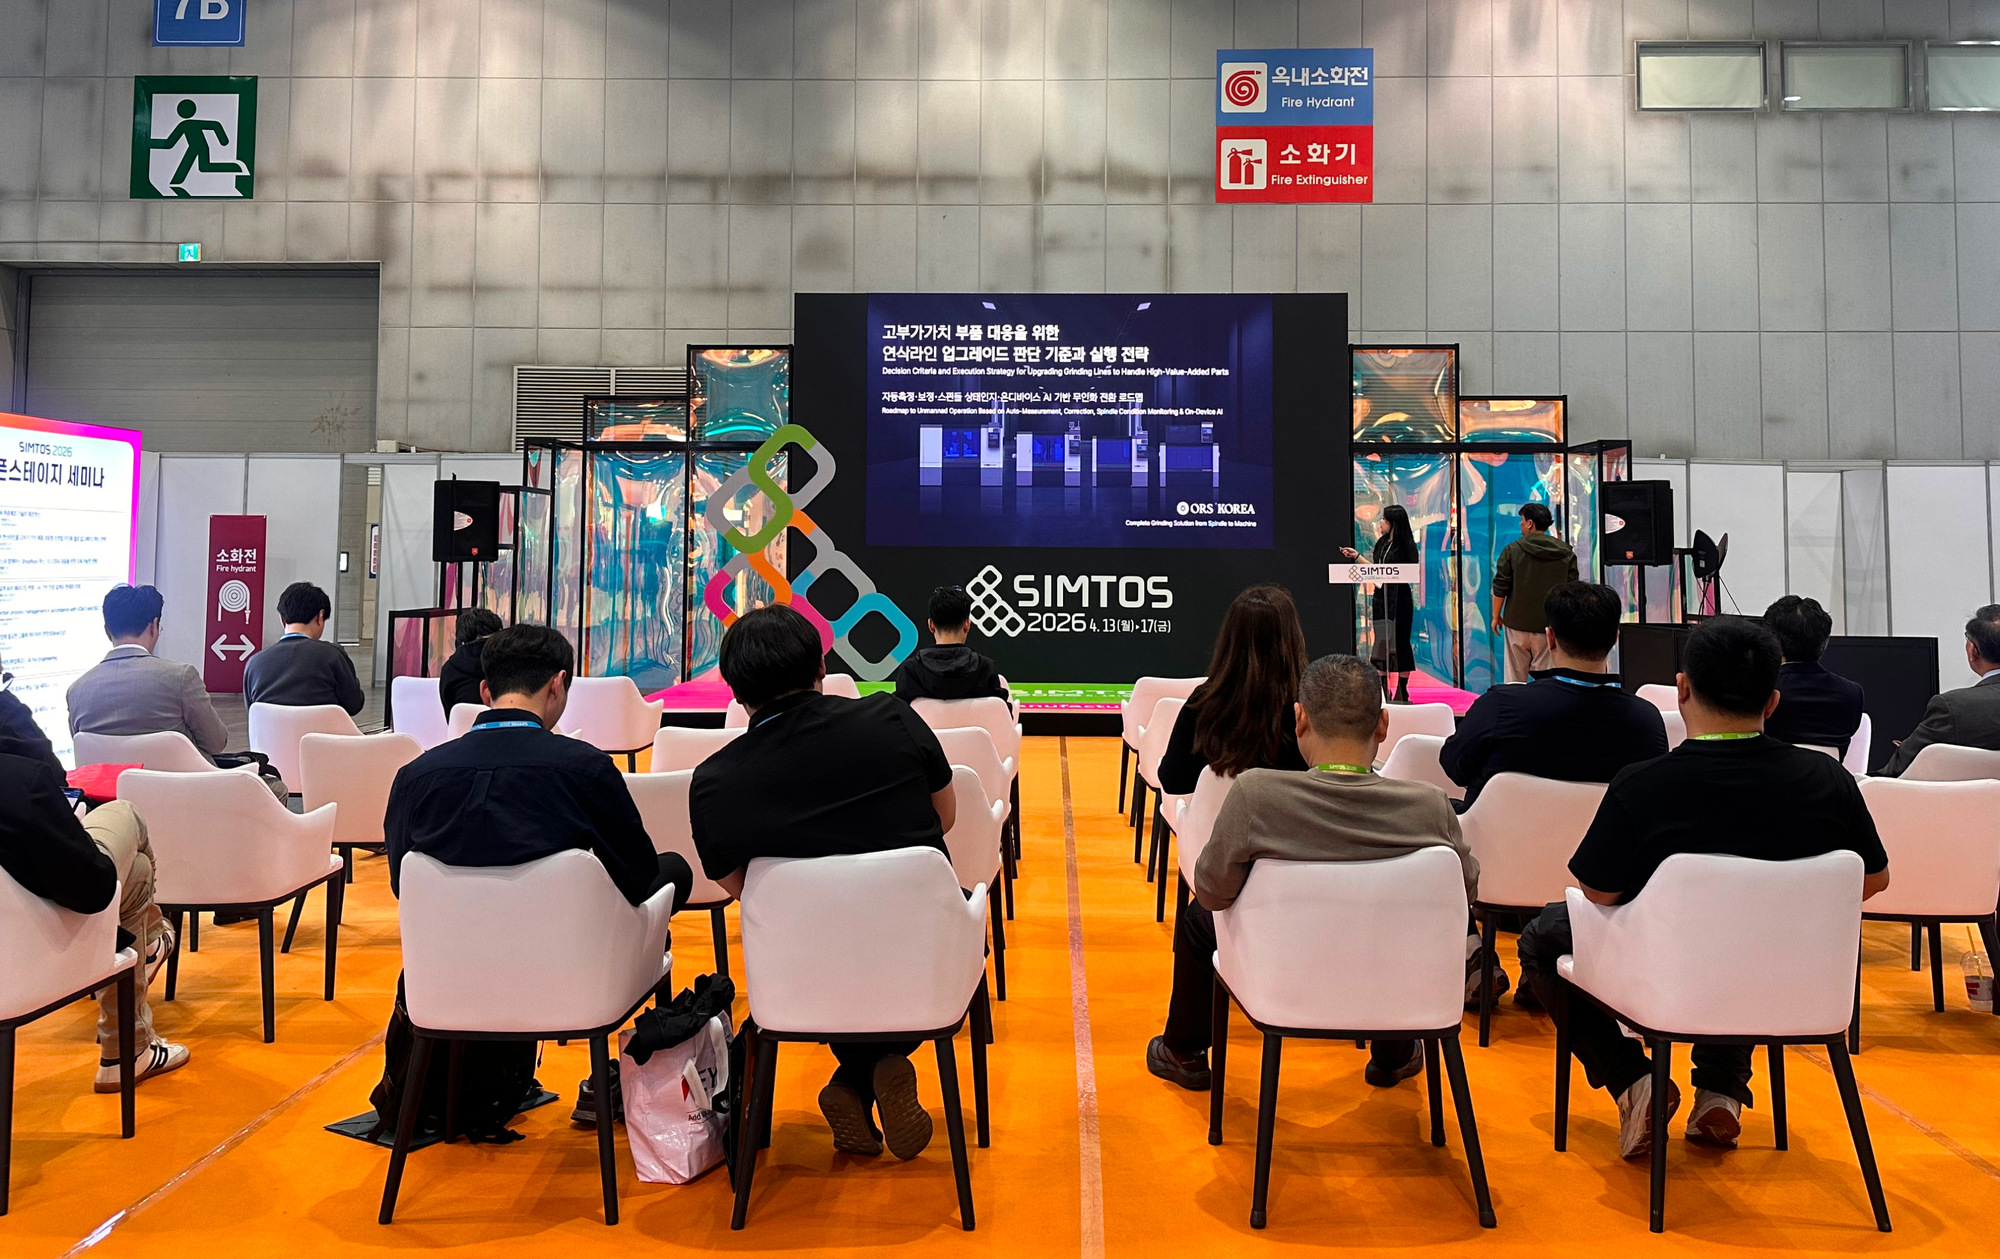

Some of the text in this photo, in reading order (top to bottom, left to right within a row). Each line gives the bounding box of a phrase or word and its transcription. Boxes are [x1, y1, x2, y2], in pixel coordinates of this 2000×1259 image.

[1271, 66, 1368, 86] 옥내소화전
[1281, 96, 1355, 109] Fire Hydrant
[1271, 174, 1368, 187] Fire Extinguisher
[882, 324, 1060, 341] 고부가가치 부품 대응을 위한
[882, 346, 1149, 363] 연삭라인 업그레이드 판단 기준과 실행 전략
[882, 367, 911, 375] Decision
[912, 367, 937, 375] Criteria
[952, 367, 985, 375] Execution
[986, 367, 1015, 377] Strategy
[1016, 367, 1026, 376] for
[1027, 367, 1063, 377] Upgrading
[1063, 368, 1092, 377] Grinding
[1093, 368, 1111, 376] Lines
[1121, 368, 1145, 376] Handle
[1146, 368, 1209, 378] High-Value-Added
[1211, 368, 1229, 376] Parts
[1043, 394, 1052, 402] AI
[1054, 393, 1071, 402] 기반
[1073, 393, 1098, 402] 무인화
[1118, 393, 1143, 403] 로드맵
[881, 407, 909, 415] Roadmap
[949, 407, 977, 415] Operation
[1096, 408, 1119, 416] Spindle
[1147, 408, 1179, 416] Monitoring
[19, 441, 73, 457] SIMTOS 2026
[67, 465, 105, 489] 세미나
[1190, 503, 1255, 514] ORS KOREA
[1151, 520, 1173, 528] Grinding
[1208, 520, 1227, 528] Spindle
[216, 548, 257, 564] 소화전
[216, 564, 257, 573] Fire hydrant
[1360, 567, 1400, 575] SIMTOS
[1013, 574, 1174, 608] SIMTOS
[1027, 612, 1086, 632] 2026
[688, 1112, 702, 1121] Add
